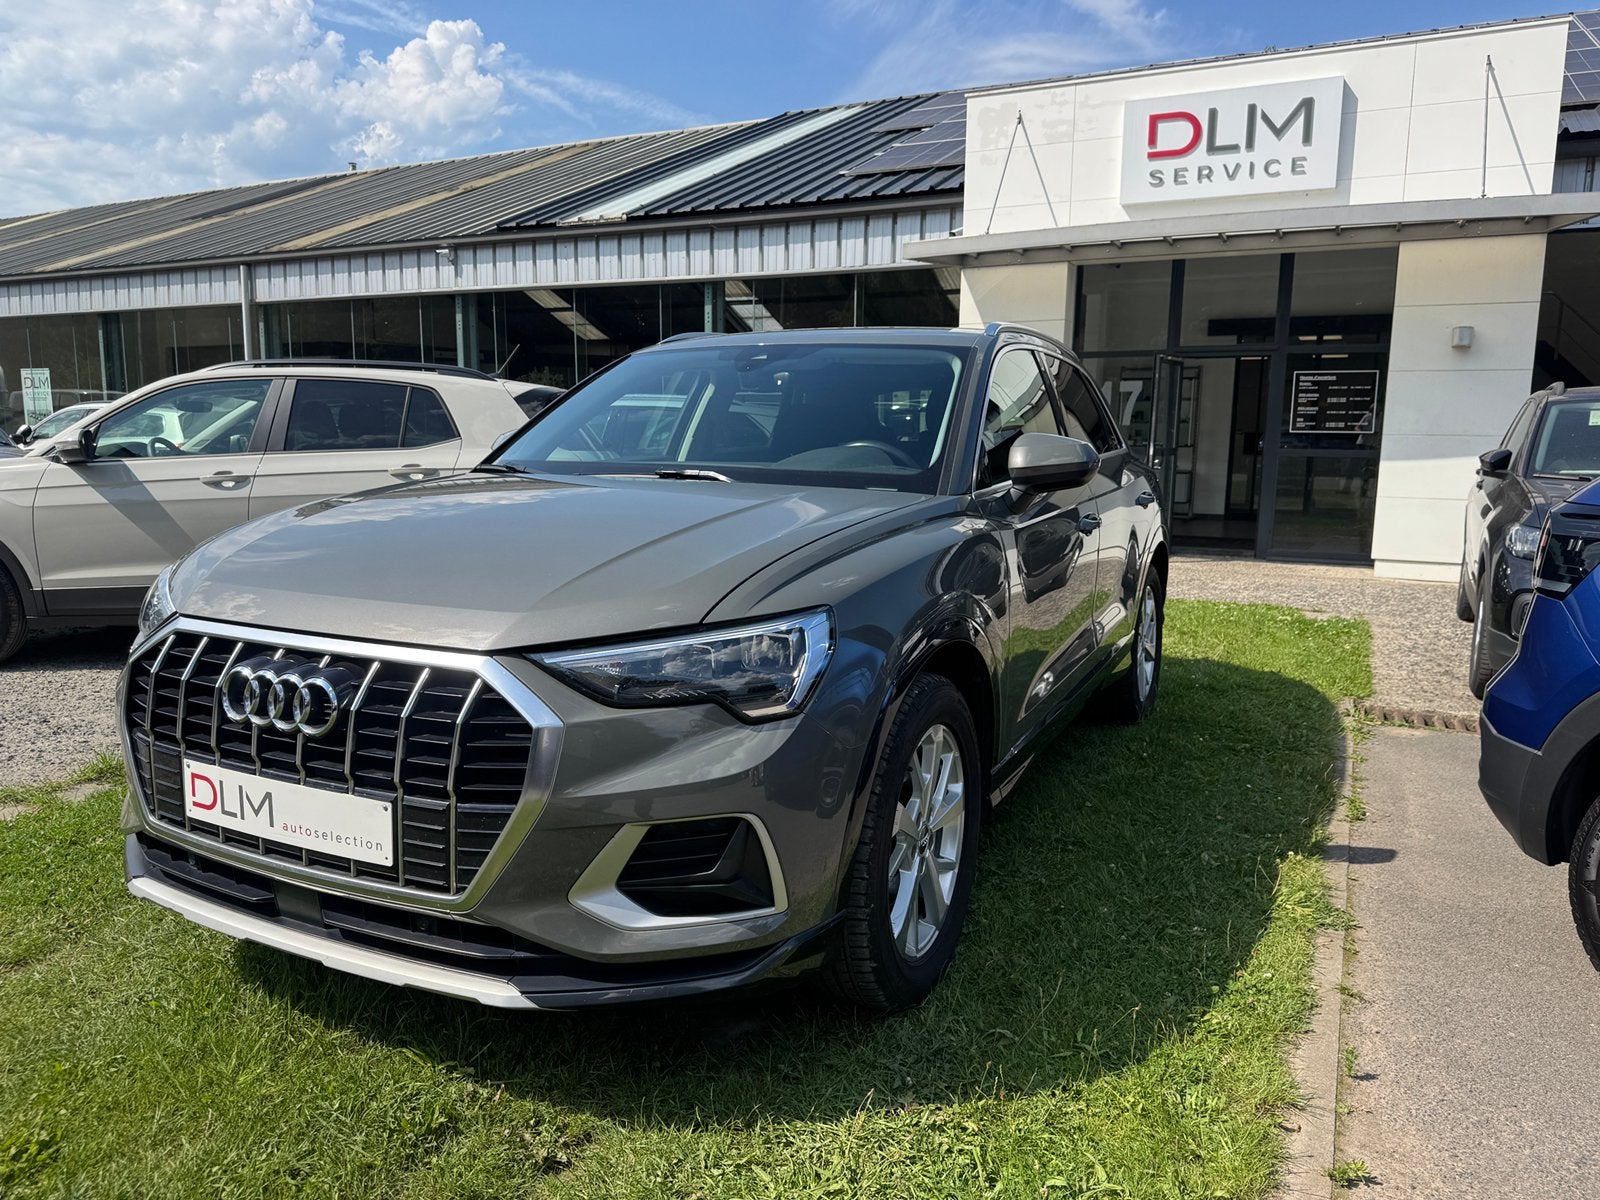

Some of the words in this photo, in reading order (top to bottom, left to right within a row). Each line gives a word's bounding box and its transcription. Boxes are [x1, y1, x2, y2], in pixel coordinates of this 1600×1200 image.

[1147, 96, 1315, 161] DLM
[1149, 156, 1308, 188] SERVICE
[24, 376, 50, 389] DLM
[190, 772, 275, 828] DLM
[282, 821, 383, 851] autoselection
